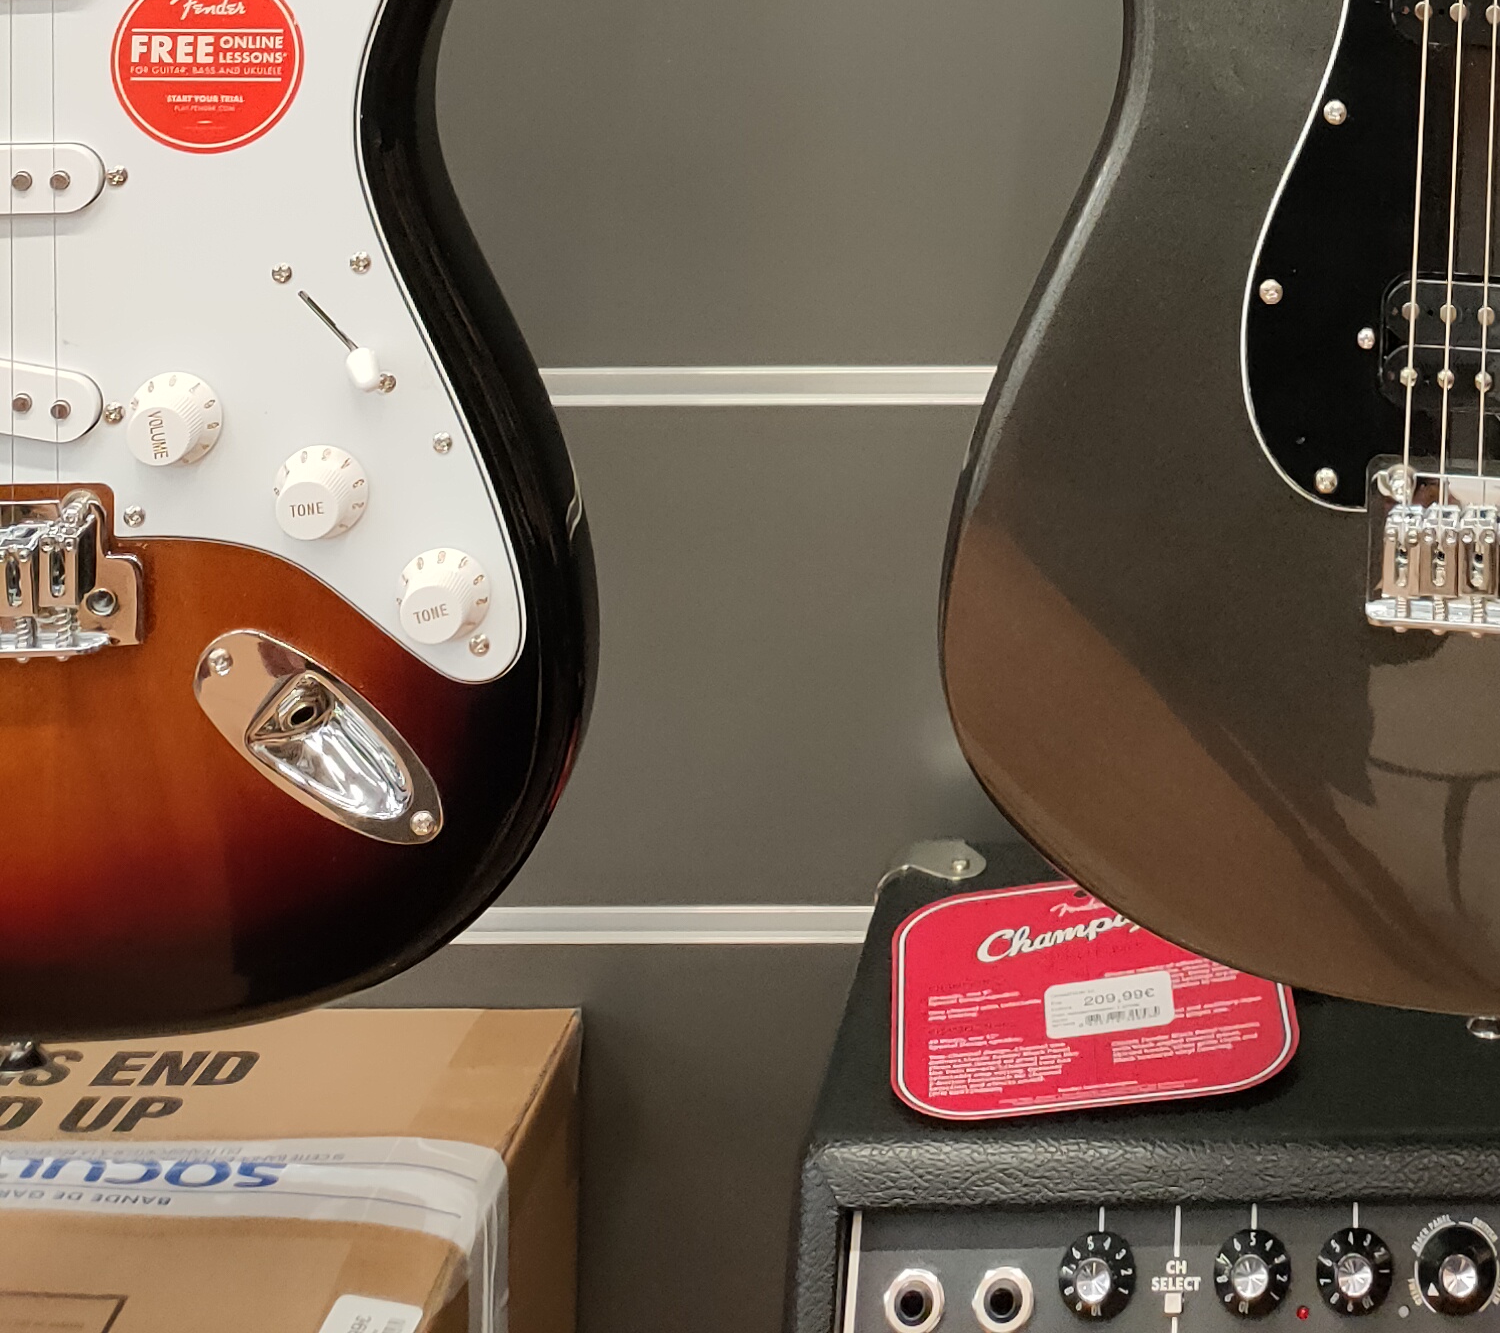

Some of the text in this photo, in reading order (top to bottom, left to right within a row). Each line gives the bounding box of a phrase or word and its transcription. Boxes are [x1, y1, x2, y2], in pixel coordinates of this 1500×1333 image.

[130, 35, 284, 64] FREE ONLINE
[130, 66, 149, 75] FOR
[192, 66, 216, 75] BASS
[219, 66, 241, 75] AND
[243, 66, 282, 75] UKULELE
[167, 95, 244, 103] START YOUR TRIAL
[147, 410, 169, 460] VOLUME
[289, 501, 325, 518] TONE
[413, 603, 449, 624] TONE
[88, 1050, 261, 1087] END
[58, 1096, 184, 1133] UP
[52, 1191, 84, 1201] DE
[91, 1193, 172, 1206] BANDE
[1087, 1235, 1095, 1250] 5
[1249, 1232, 1257, 1246] 5
[1165, 1260, 1188, 1275] CH
[1151, 1276, 1202, 1292] SELECT
